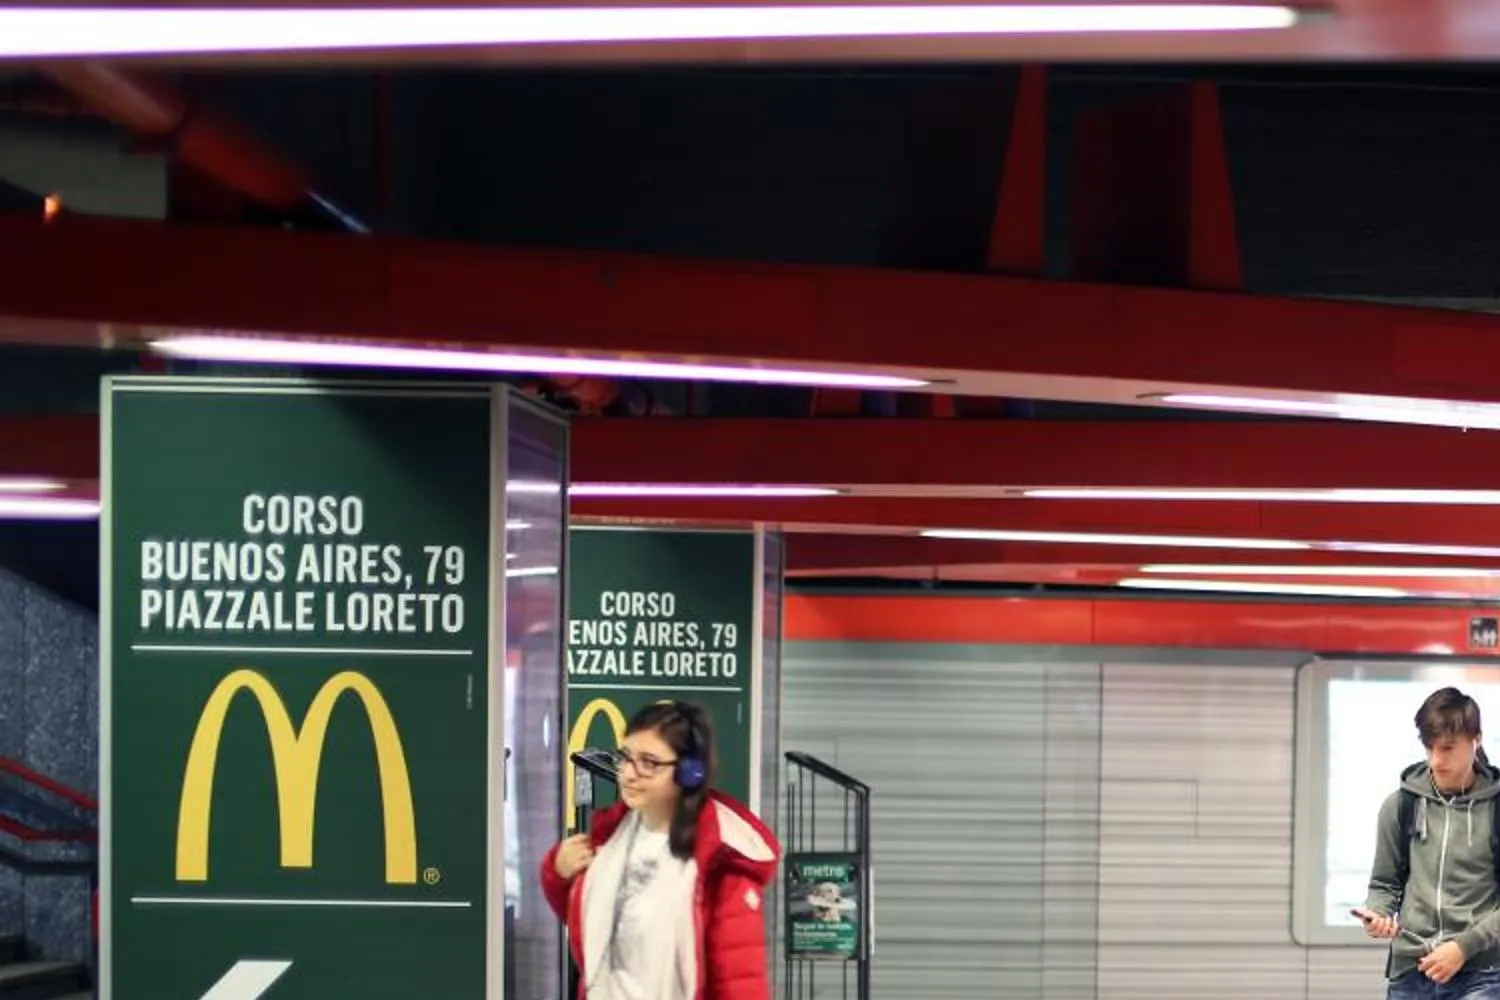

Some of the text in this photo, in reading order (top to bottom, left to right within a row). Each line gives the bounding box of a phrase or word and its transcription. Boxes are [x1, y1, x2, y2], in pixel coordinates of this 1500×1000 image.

[243, 494, 363, 535] CORSO
[141, 541, 465, 590] BUENOS AIRES, 79
[140, 589, 465, 633] PIAZZALE LORETO
[601, 591, 675, 617] CORSO
[569, 620, 737, 650] ENOS AIRES, 79
[568, 649, 737, 677] AZZALE LORETO
